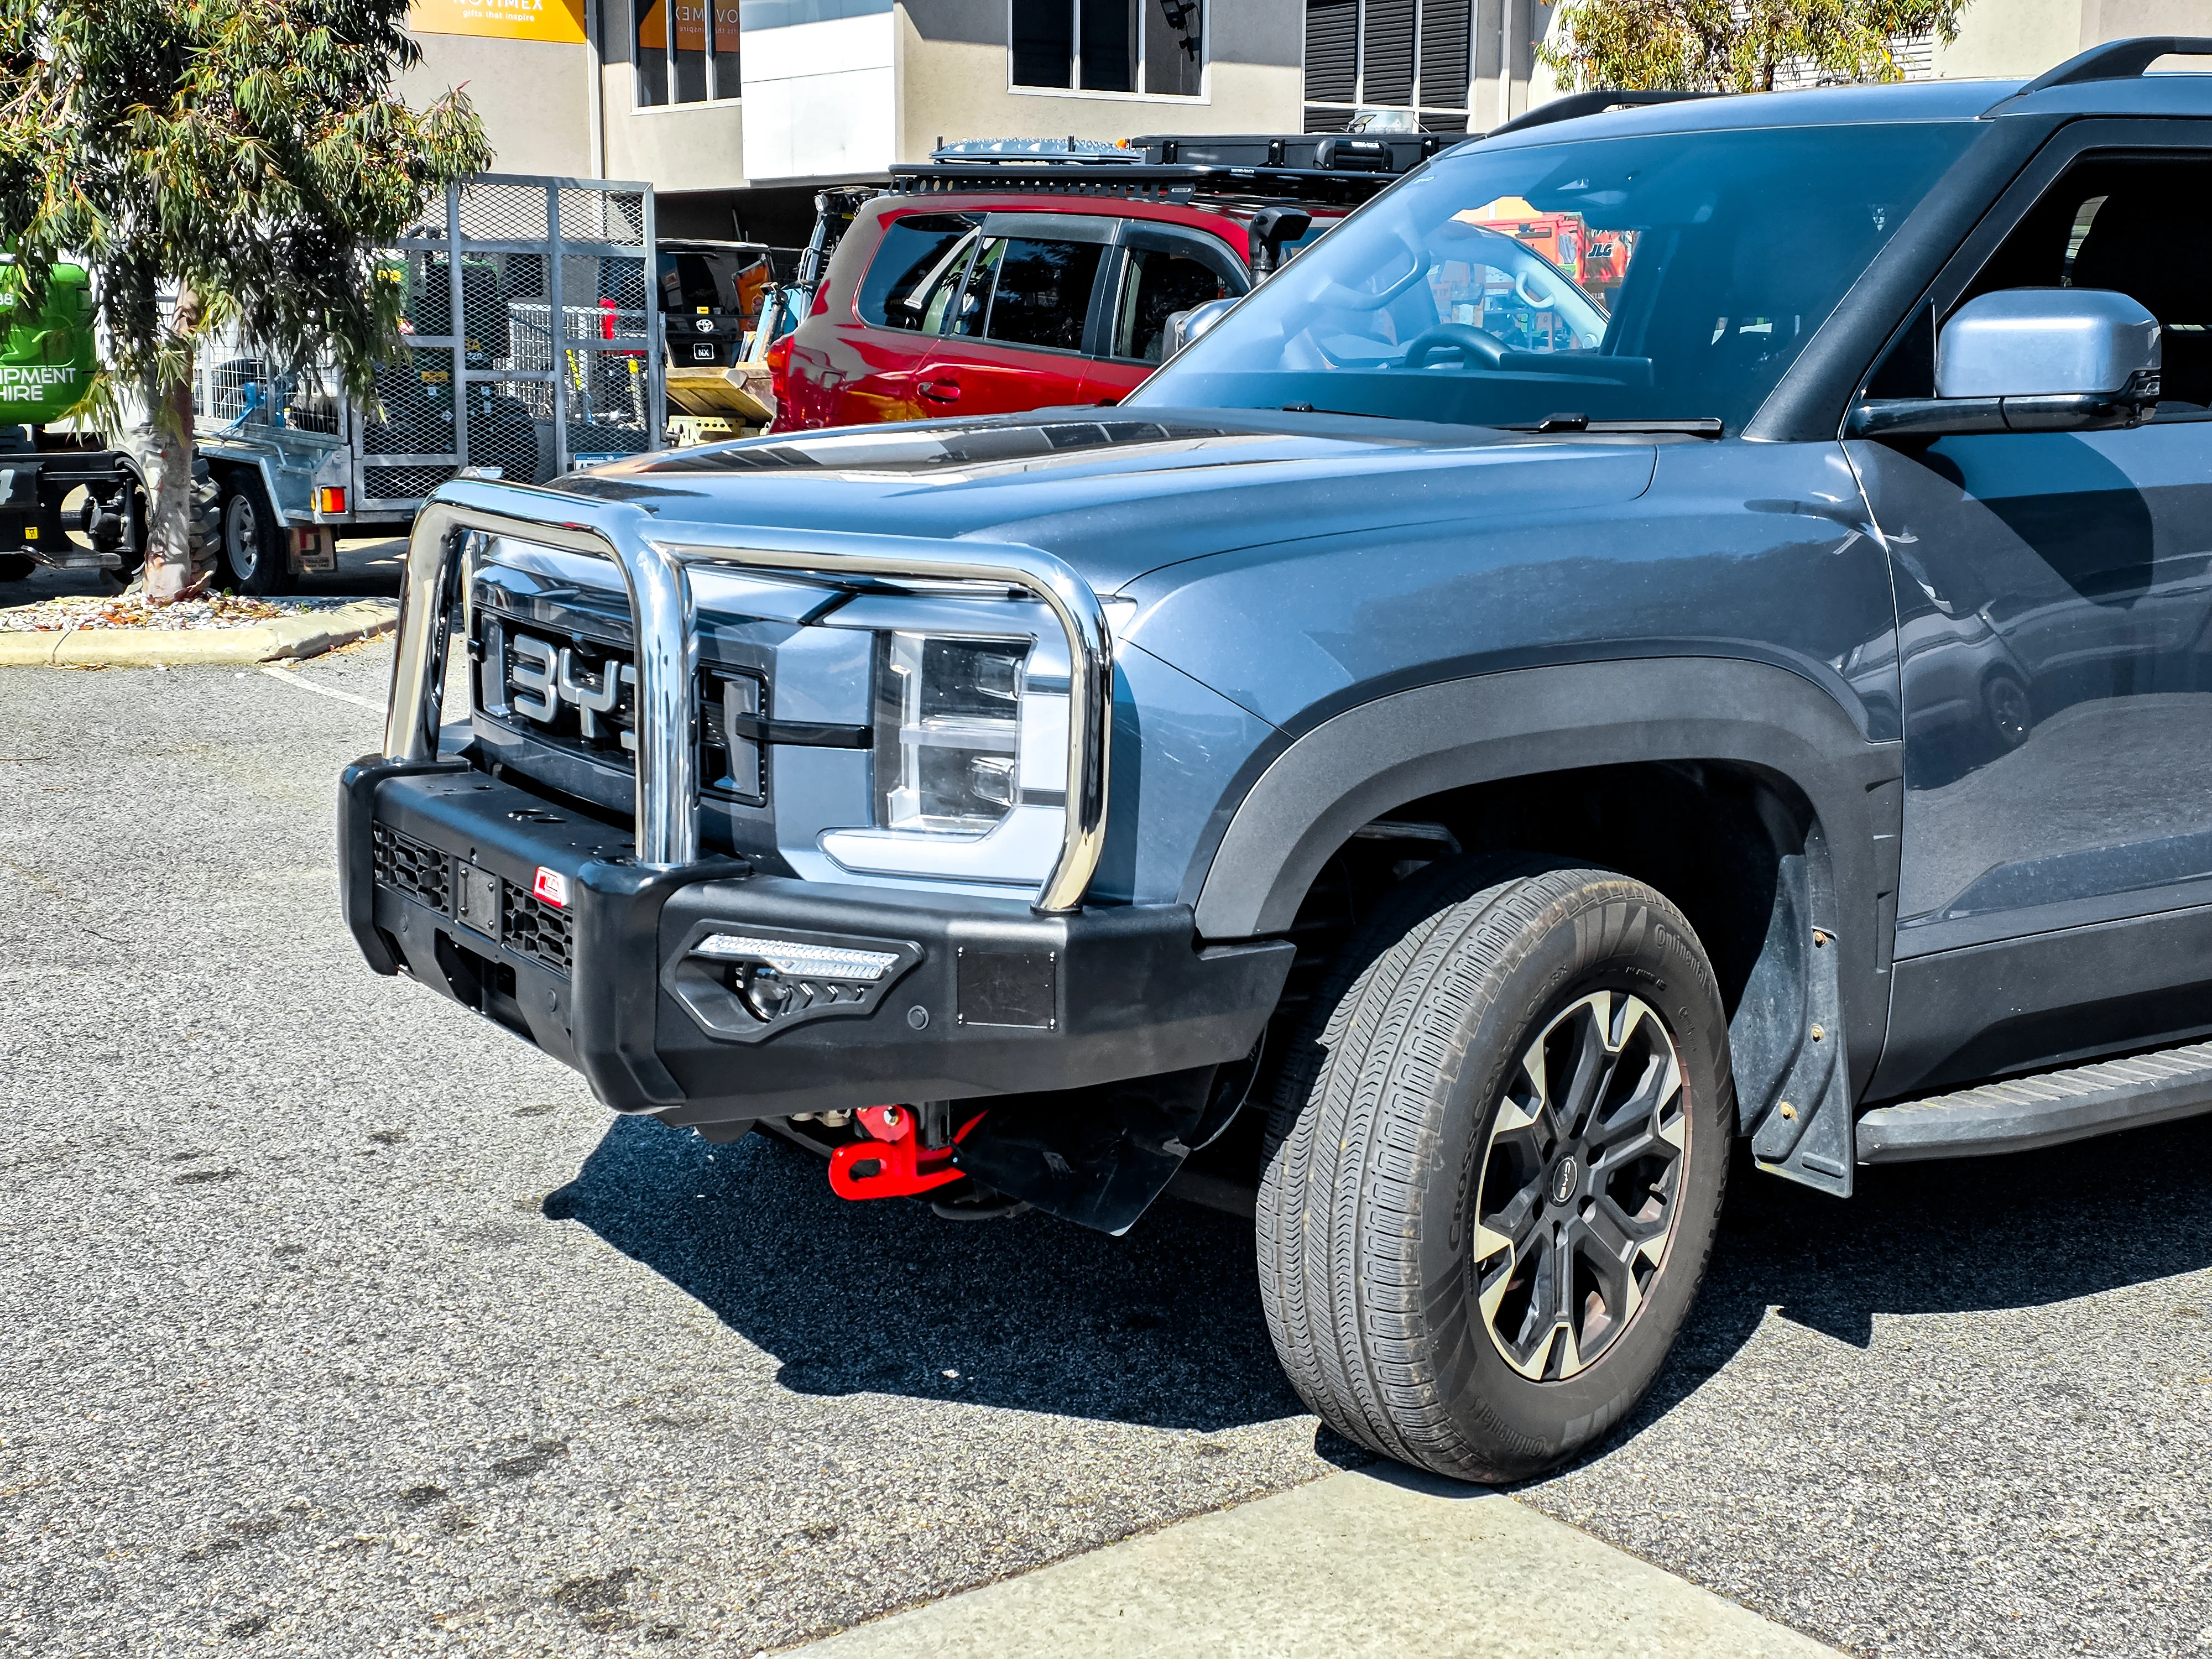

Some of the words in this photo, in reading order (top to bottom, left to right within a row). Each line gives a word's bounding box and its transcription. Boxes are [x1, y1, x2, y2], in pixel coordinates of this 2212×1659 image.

[453, 0, 542, 10] VIMEX
[462, 9, 482, 18] gifts
[485, 11, 502, 19] that
[505, 12, 534, 22] inspire
[1587, 243, 1613, 257] JLG
[513, 634, 635, 751] BY
[1654, 923, 1707, 989] Continental
